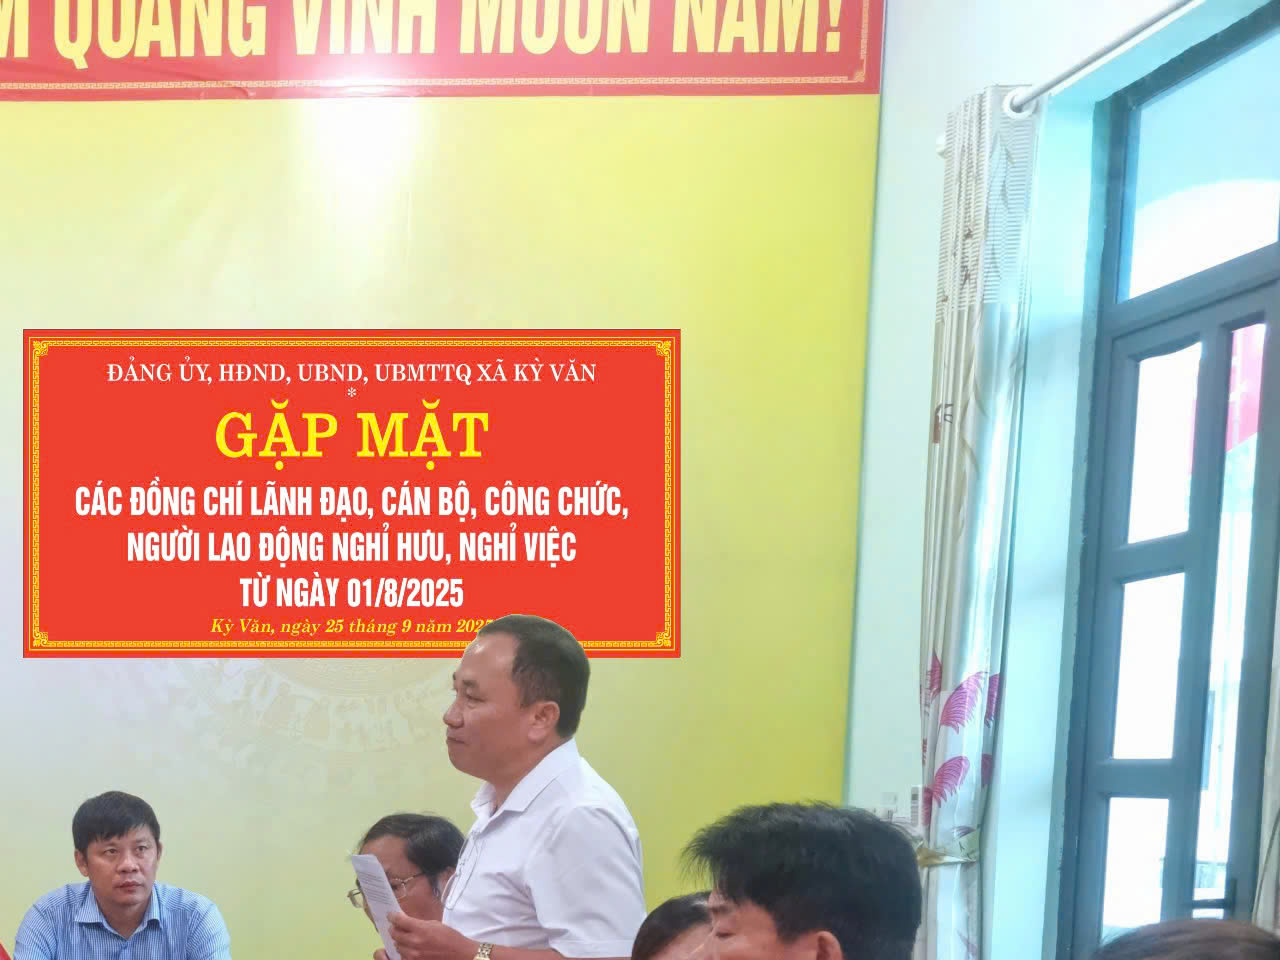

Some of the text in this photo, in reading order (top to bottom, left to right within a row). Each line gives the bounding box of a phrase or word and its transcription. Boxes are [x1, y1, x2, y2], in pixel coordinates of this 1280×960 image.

[54, 0, 267, 69] QUANG
[292, 0, 438, 56] VINH
[106, 355, 597, 386] ĐẢNG ỦY, HĐND, UBND, UBMTTQ XÃ KỲ VĂN
[215, 398, 489, 471] GẶP MẶT
[75, 476, 629, 524] CÁC ĐỒNG CHÍ LÃNH ĐẠO, CÁN BỘ, CÔNG CHỨC,
[127, 522, 577, 569] NGƯỜI LAO ĐỘNG NGHỈ HƯU, NGHỈ VIỆC
[239, 574, 464, 608] TỪ NGÀY 01/8/2025
[210, 617, 234, 637] Kỳ
[239, 617, 275, 636] Văn,
[280, 618, 320, 637] ngày
[324, 619, 345, 633] 25
[349, 618, 398, 637] tháng
[401, 618, 412, 633] 9
[415, 618, 452, 633] năm
